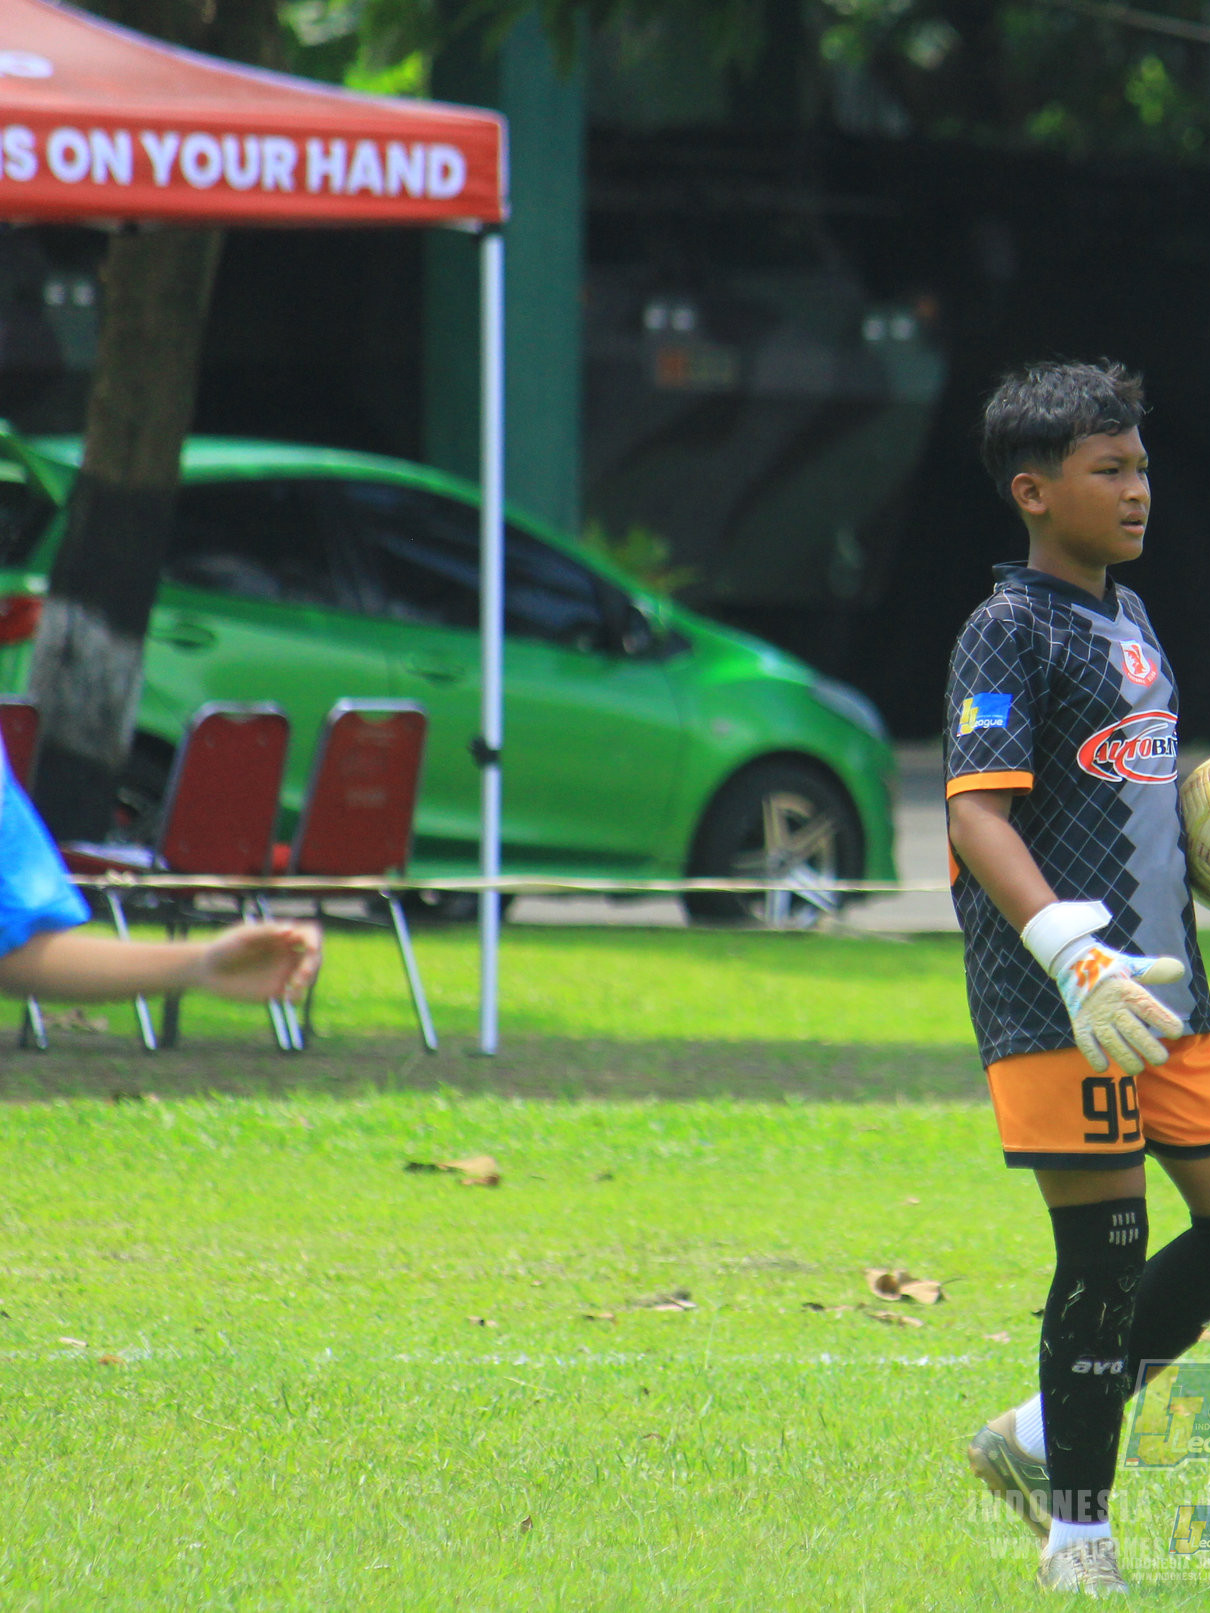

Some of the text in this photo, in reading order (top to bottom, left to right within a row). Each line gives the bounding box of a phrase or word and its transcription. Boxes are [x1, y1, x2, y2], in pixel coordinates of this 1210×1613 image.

[0, 125, 466, 199] S ON YOUR HAND
[1081, 1076, 1140, 1144] 99
